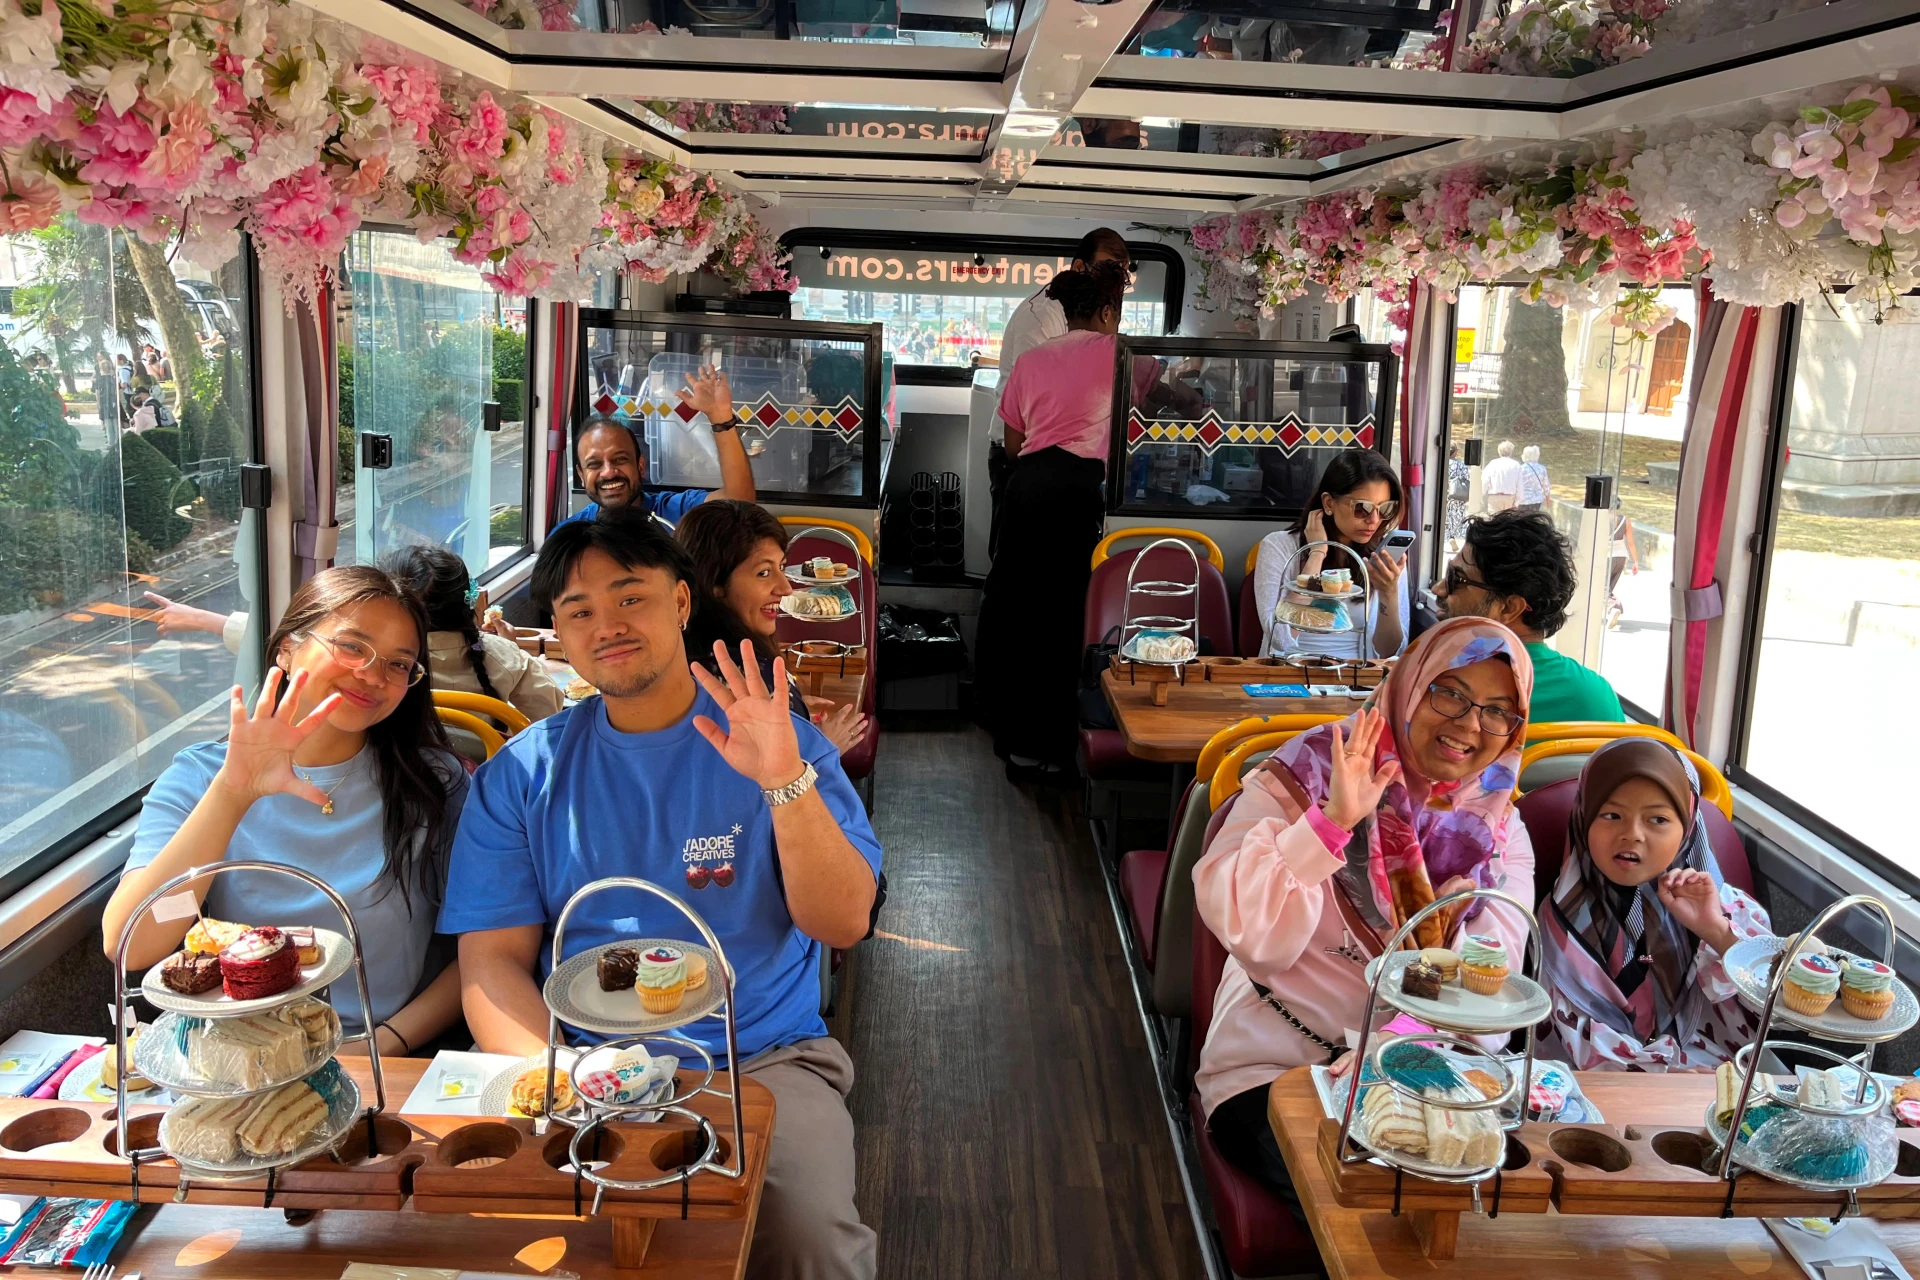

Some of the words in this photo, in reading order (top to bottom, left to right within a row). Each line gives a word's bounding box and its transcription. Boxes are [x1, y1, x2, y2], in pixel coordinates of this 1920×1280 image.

[952, 266, 990, 275] EMERGENCY
[991, 267, 1005, 276] EXIT
[682, 835, 735, 853] J'ADORE
[682, 848, 735, 862] CREATIVES
